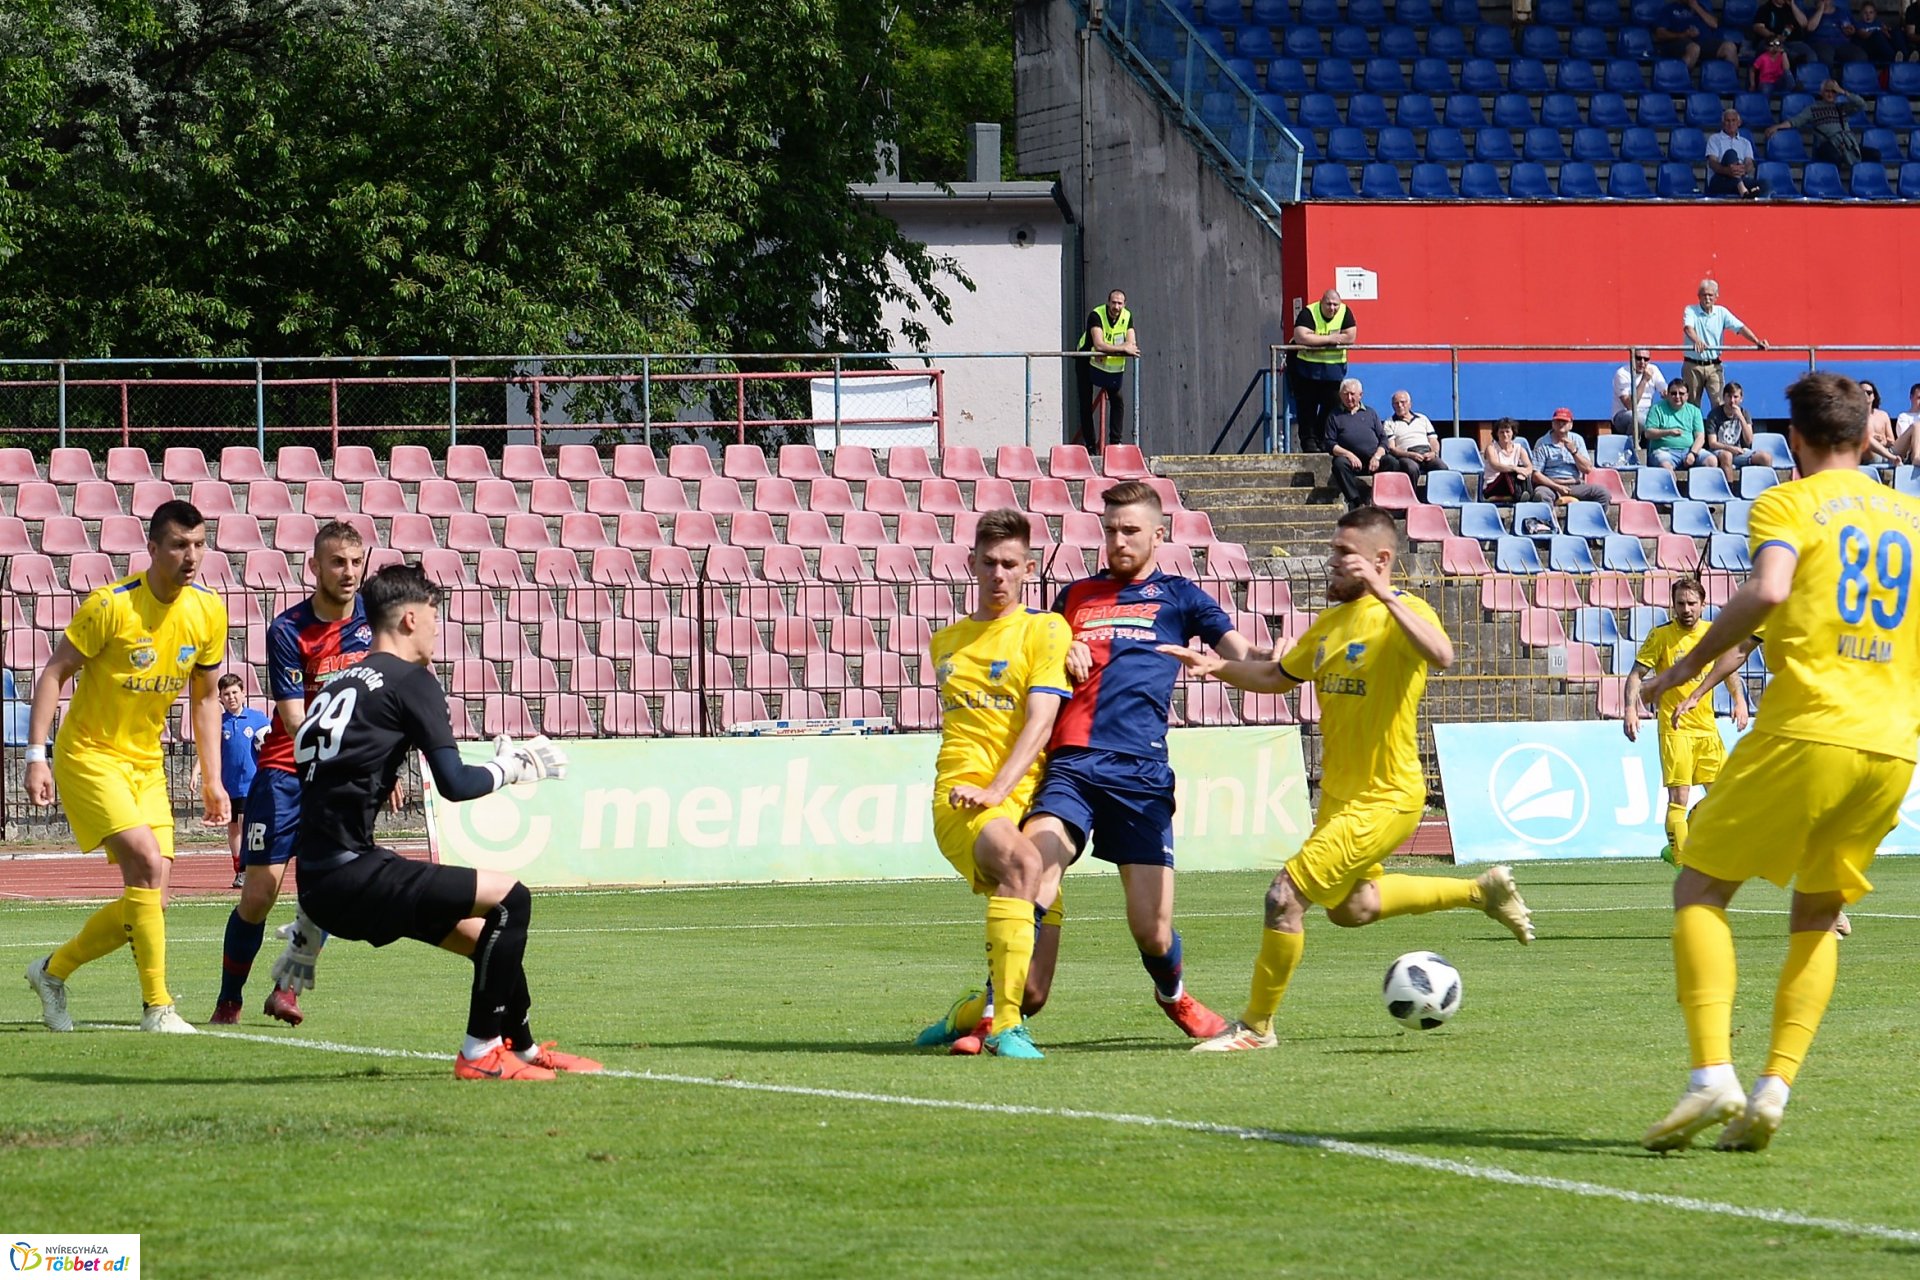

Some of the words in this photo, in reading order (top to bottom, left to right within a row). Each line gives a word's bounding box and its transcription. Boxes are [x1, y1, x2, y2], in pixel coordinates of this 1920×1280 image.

[1837, 525, 1912, 629] 89
[1552, 655, 1563, 667] 10
[1838, 634, 1892, 663] VILLÁM
[294, 687, 357, 764] 29
